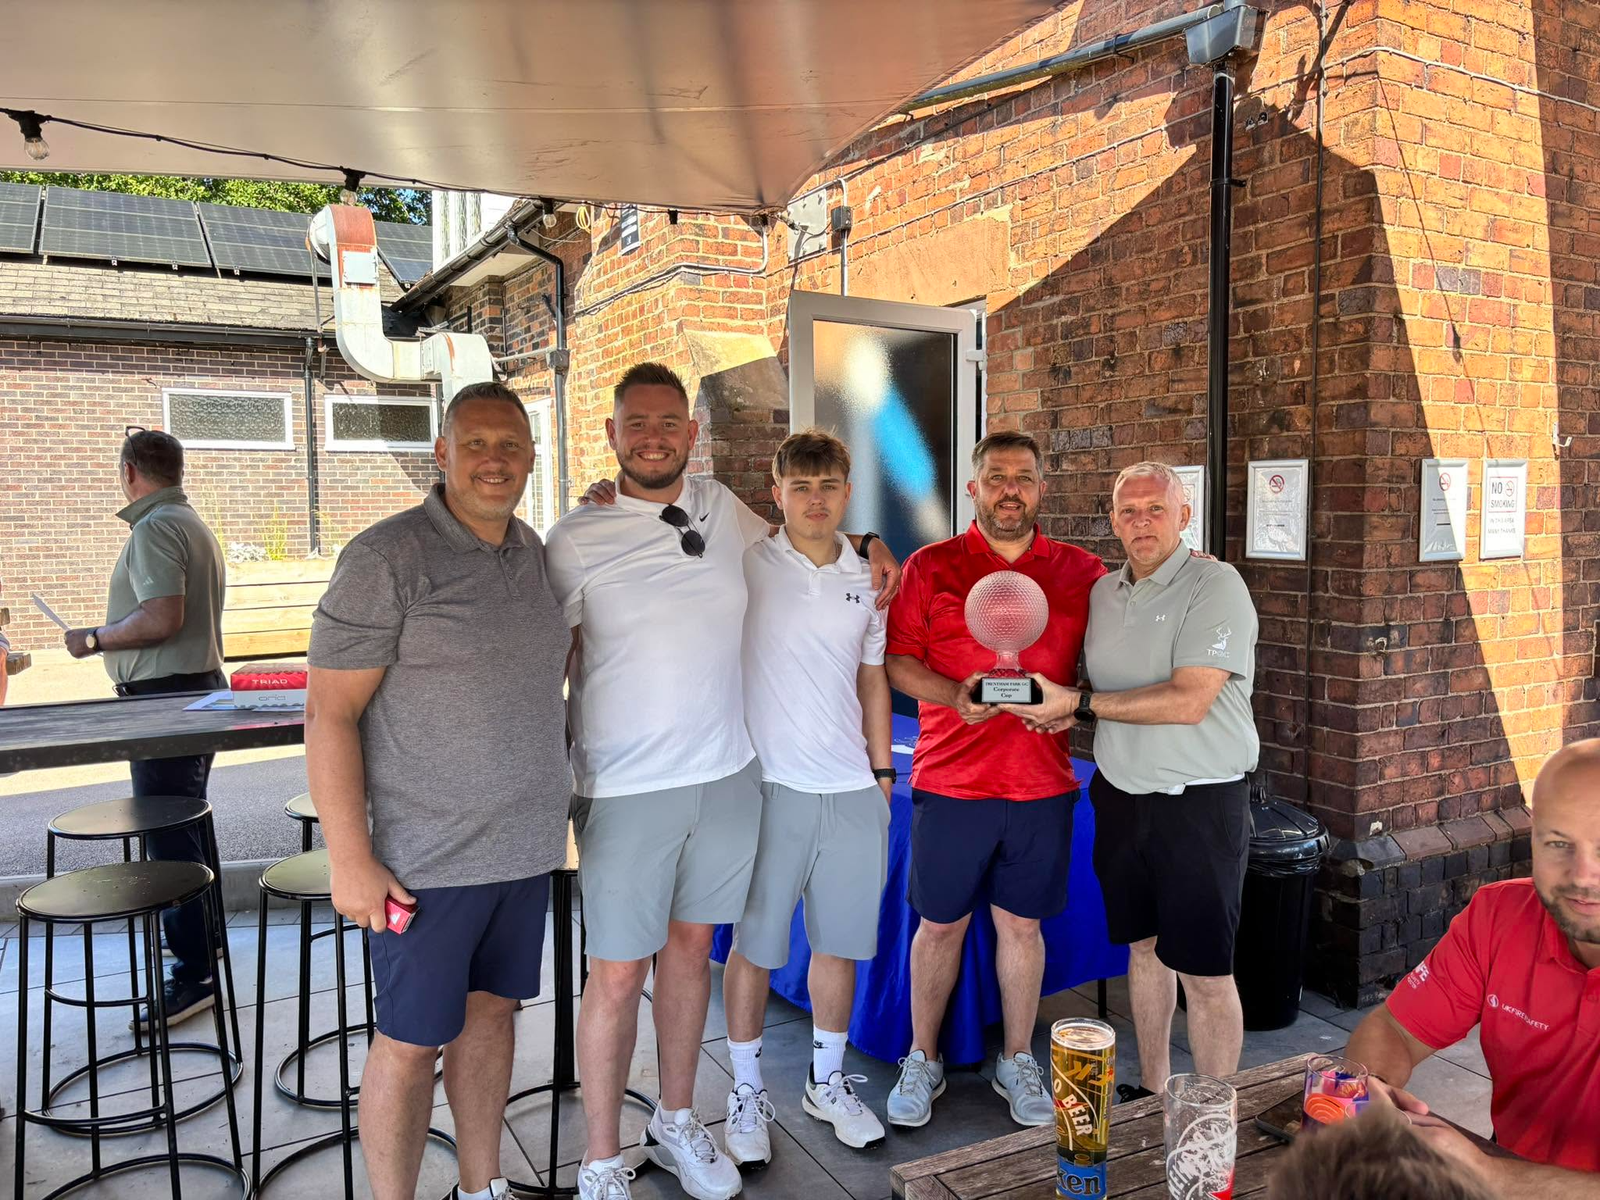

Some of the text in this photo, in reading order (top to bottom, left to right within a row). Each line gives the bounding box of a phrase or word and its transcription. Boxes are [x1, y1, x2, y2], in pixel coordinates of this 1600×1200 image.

[1491, 482, 1503, 494] NO
[1490, 499, 1515, 509] SMOKING
[1062, 1093, 1094, 1137] BEER
